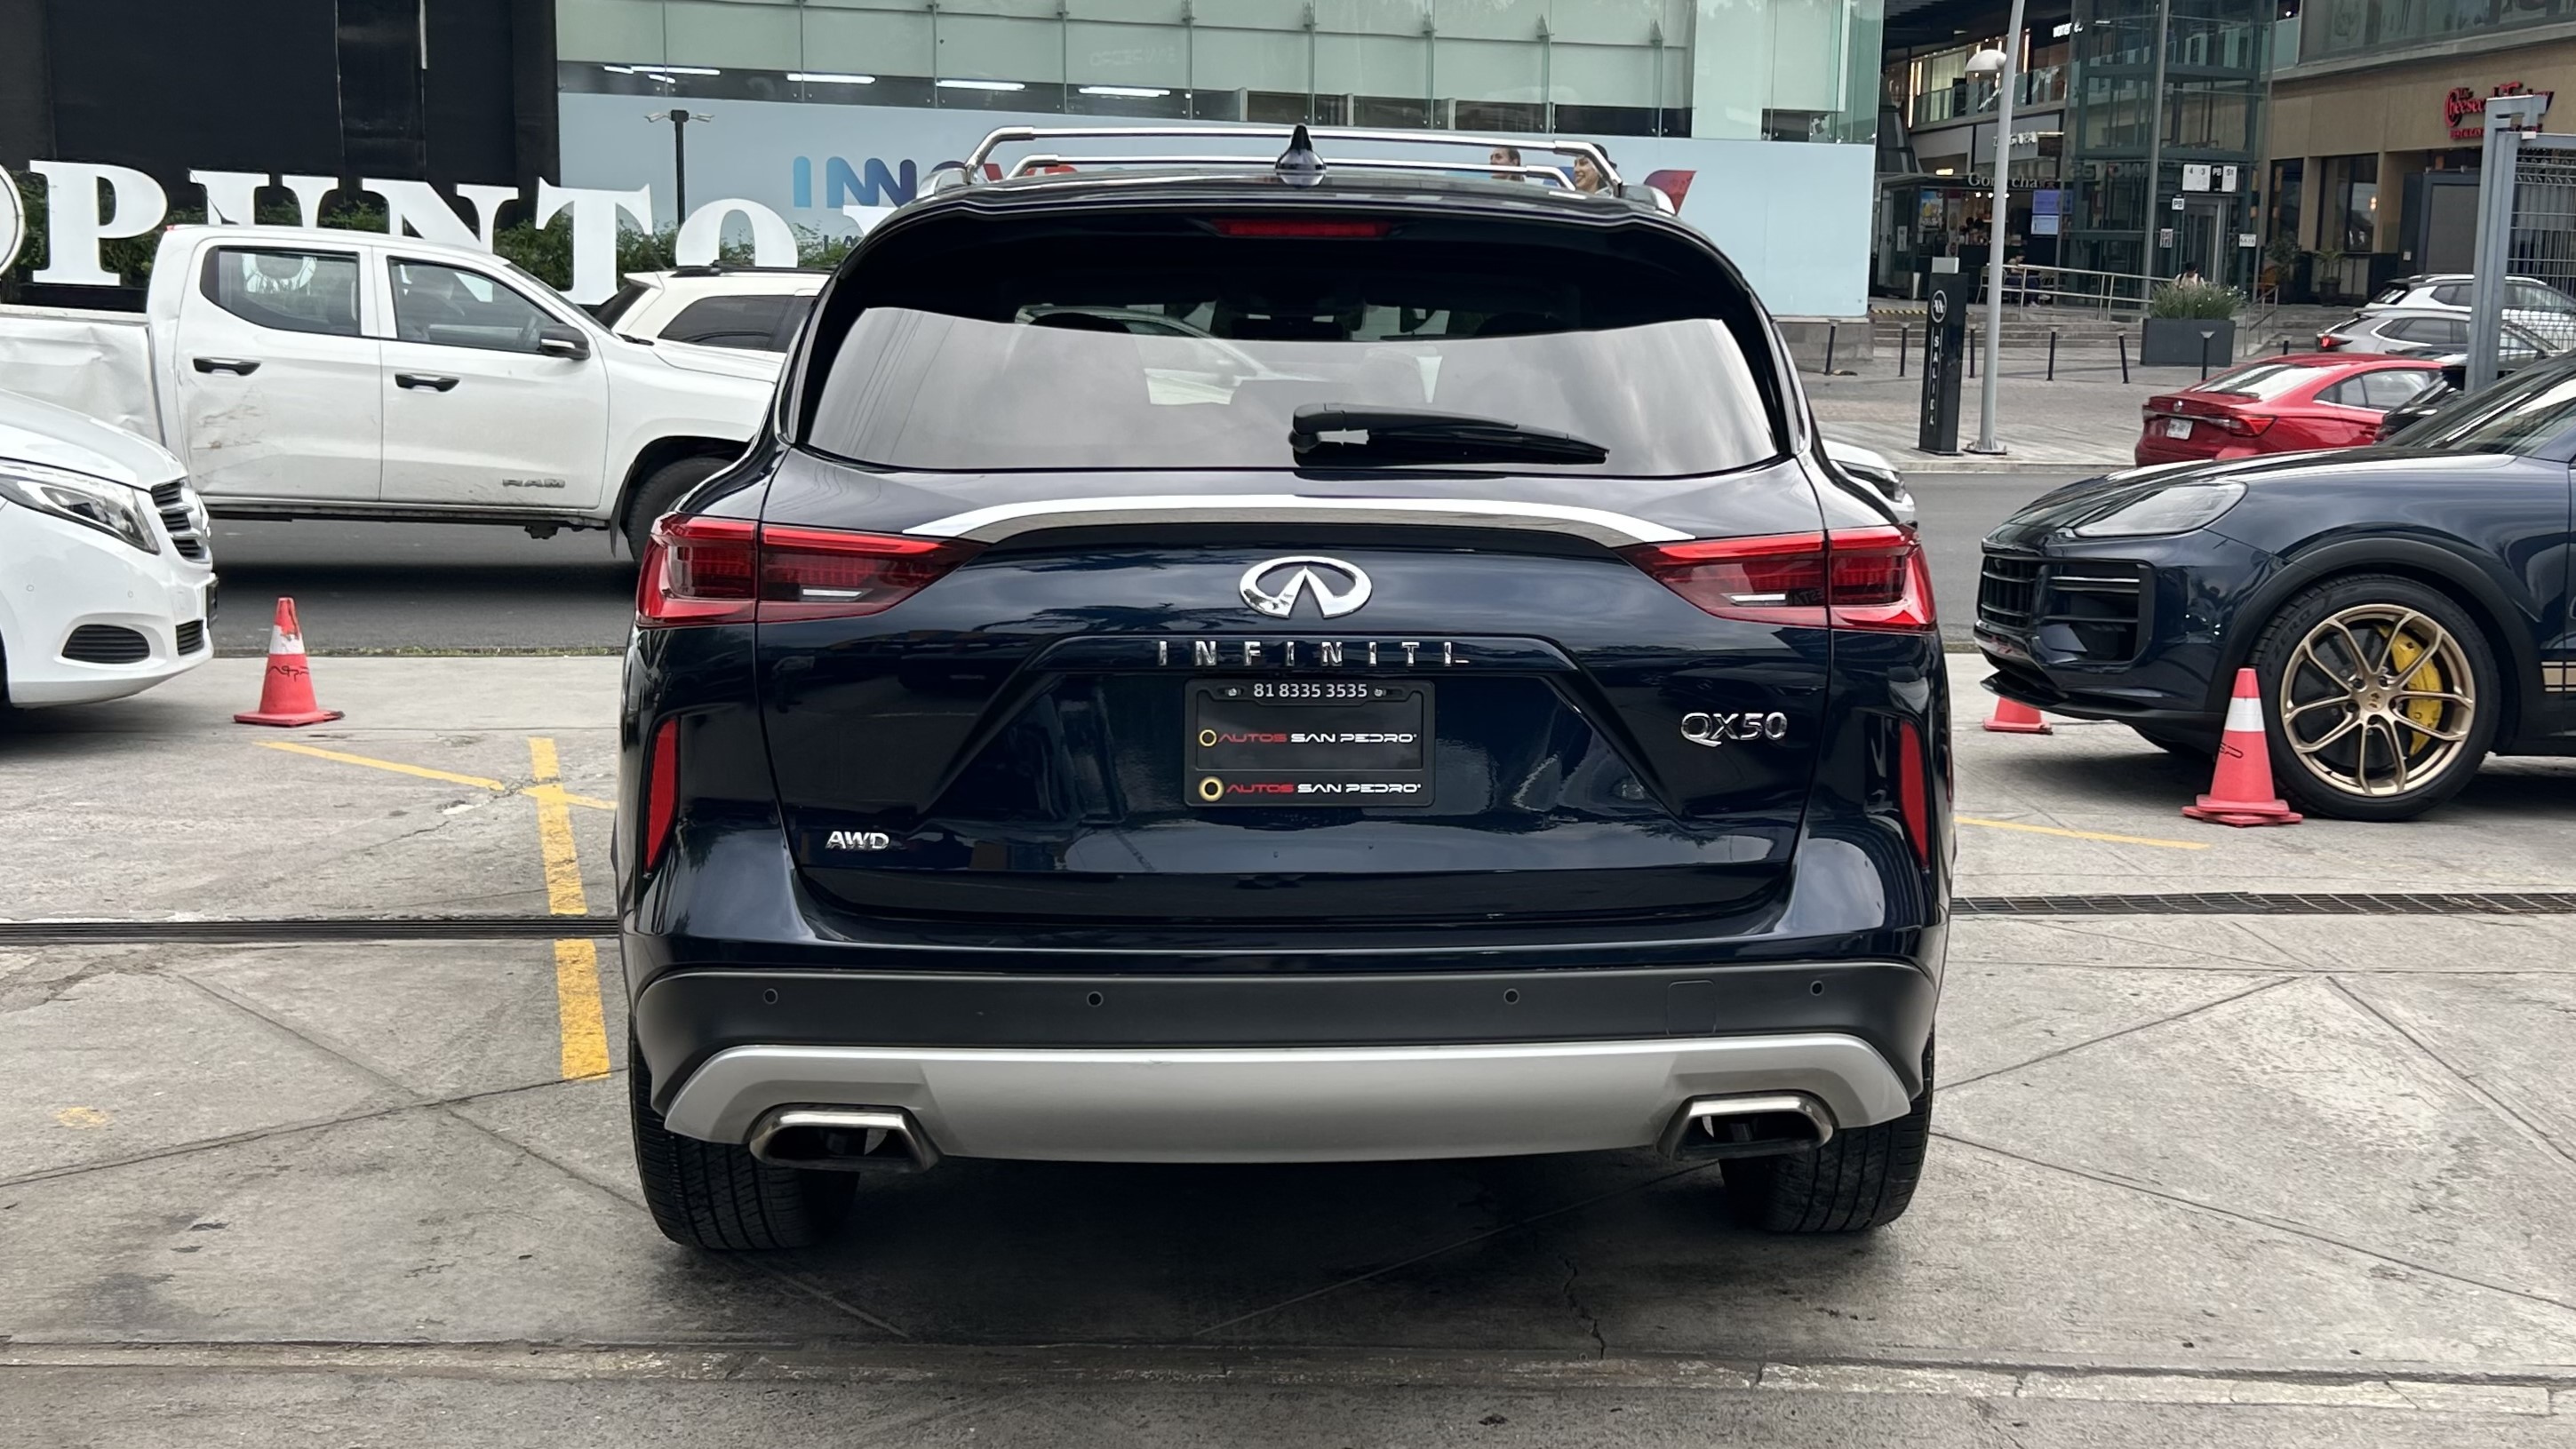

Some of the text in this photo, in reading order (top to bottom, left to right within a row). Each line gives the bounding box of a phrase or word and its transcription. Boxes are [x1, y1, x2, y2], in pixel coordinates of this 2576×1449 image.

[1968, 172, 1995, 187] Go
[2012, 174, 2038, 188] cha
[29, 159, 798, 305] PUNTO
[502, 479, 566, 489] RAM
[1159, 641, 1454, 666] INFINITI
[1253, 683, 1368, 697] 81 8335 3535
[1681, 712, 1788, 747] QX50
[1217, 733, 1414, 743] AUTOS SAN PEDRO
[1226, 784, 1418, 793] AUTOS SAN PEDRO
[825, 831, 889, 850] AWD
